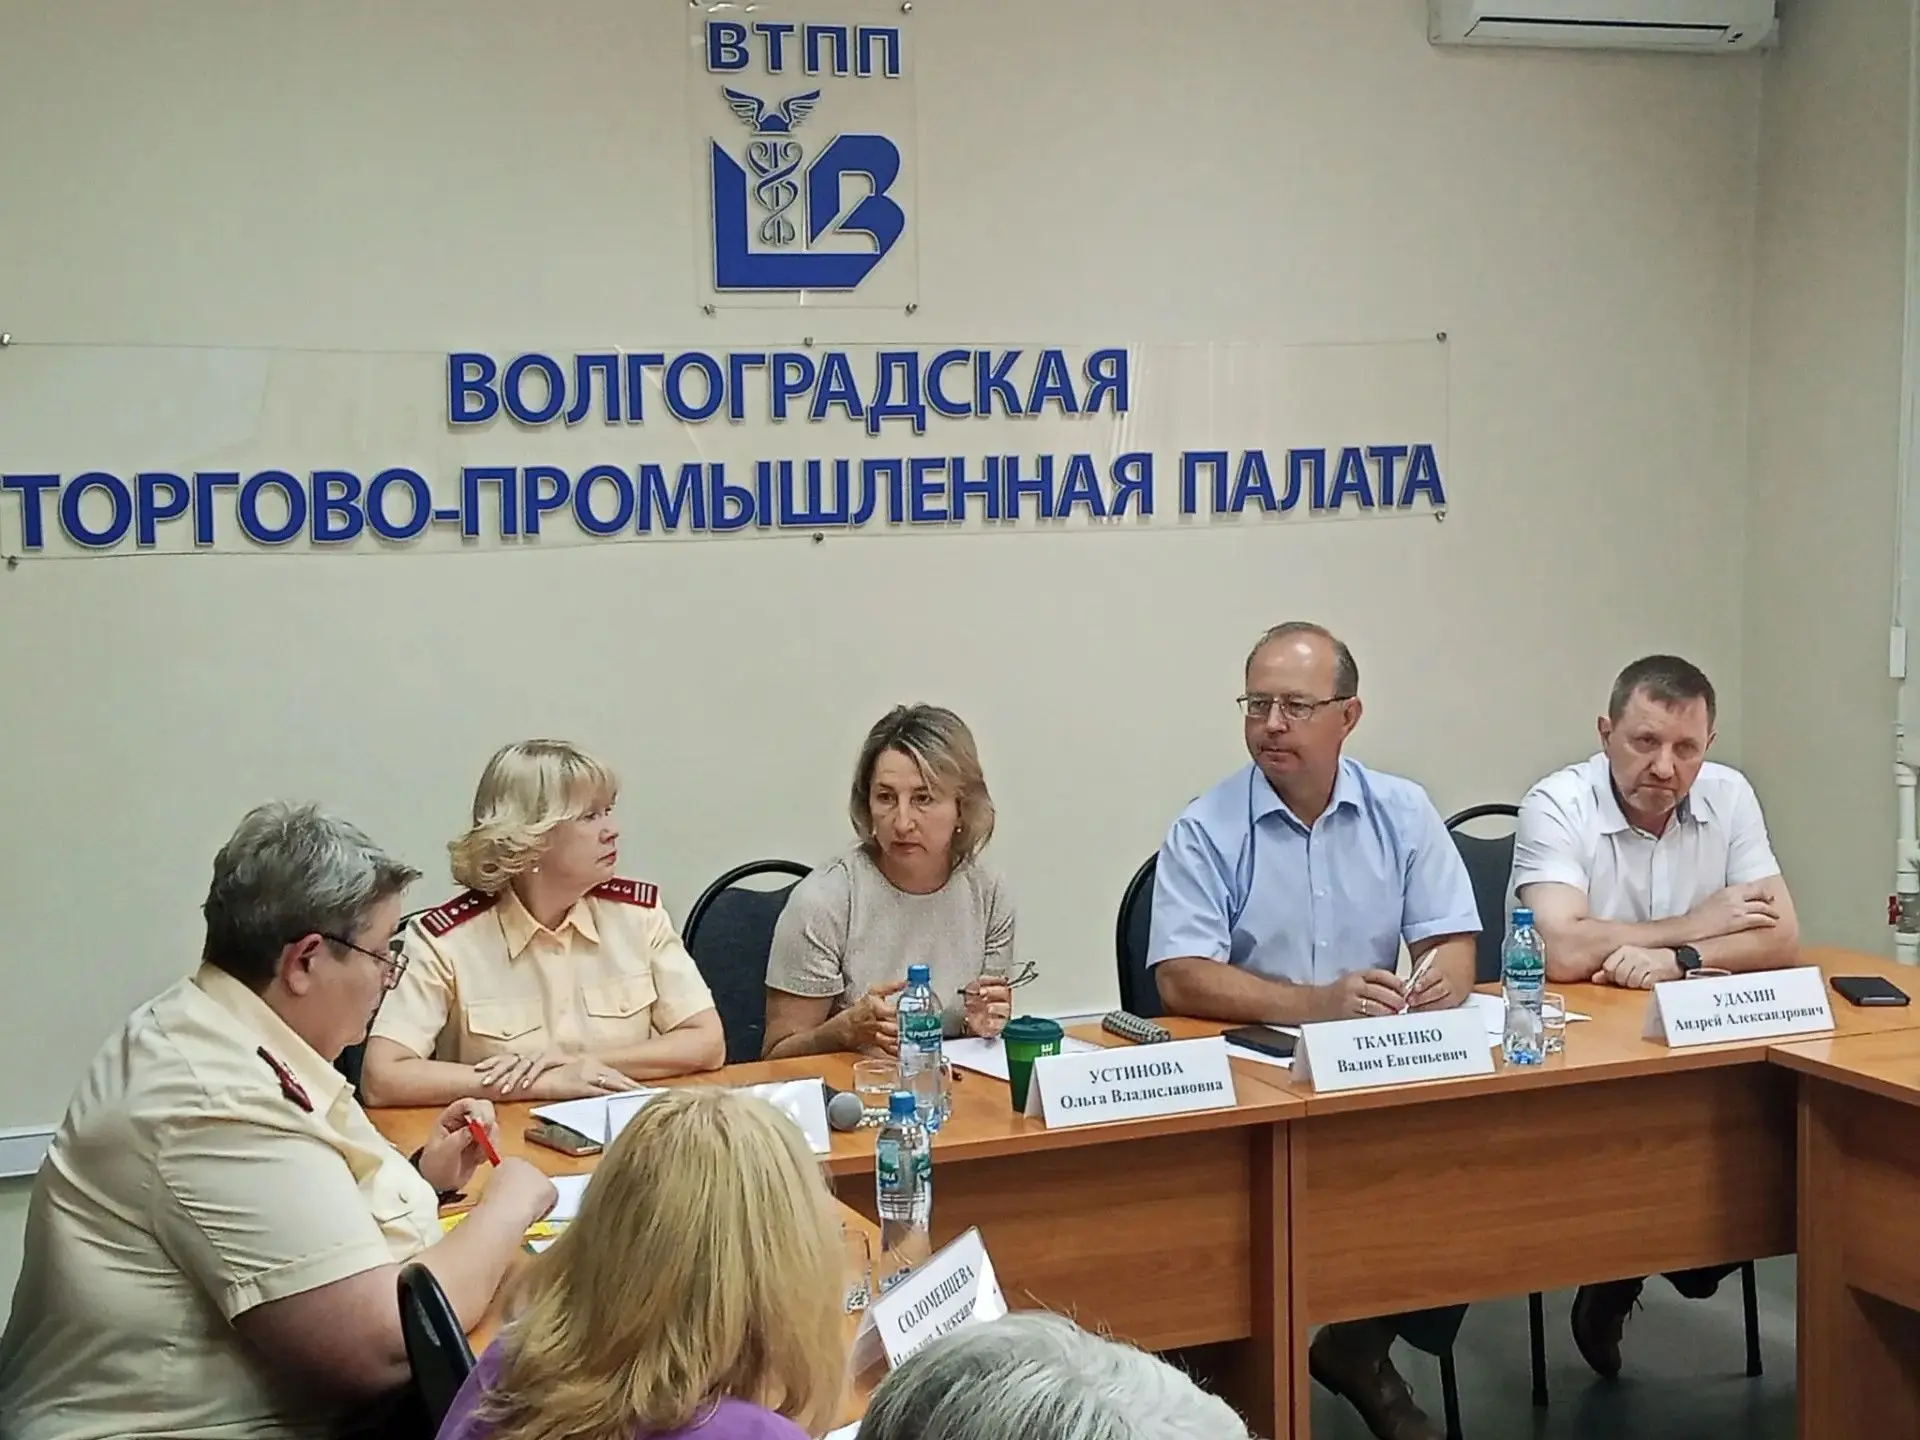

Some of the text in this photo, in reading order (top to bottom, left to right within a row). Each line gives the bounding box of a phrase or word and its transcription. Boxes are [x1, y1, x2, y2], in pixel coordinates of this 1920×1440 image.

[706, 20, 901, 78] ВТПП
[446, 348, 1130, 435] ВОЛГОГРАДСКАЯ
[1, 444, 1447, 549] ТОРГОВО-ПРОМЫШЛЕННАЯ ПАЛАТА
[1712, 988, 1777, 1007] УДАХИН
[1674, 1004, 1824, 1033] Андрей Александрович
[1352, 1027, 1443, 1051] ТКАЧЕНКО
[1088, 1060, 1184, 1085] УСТИНОВА
[1337, 1048, 1469, 1074] Вадим Евгеньевич
[1060, 1079, 1224, 1111] Ольга Владиславовна
[896, 1263, 976, 1334] СОЛОМЕНЦЕВА
